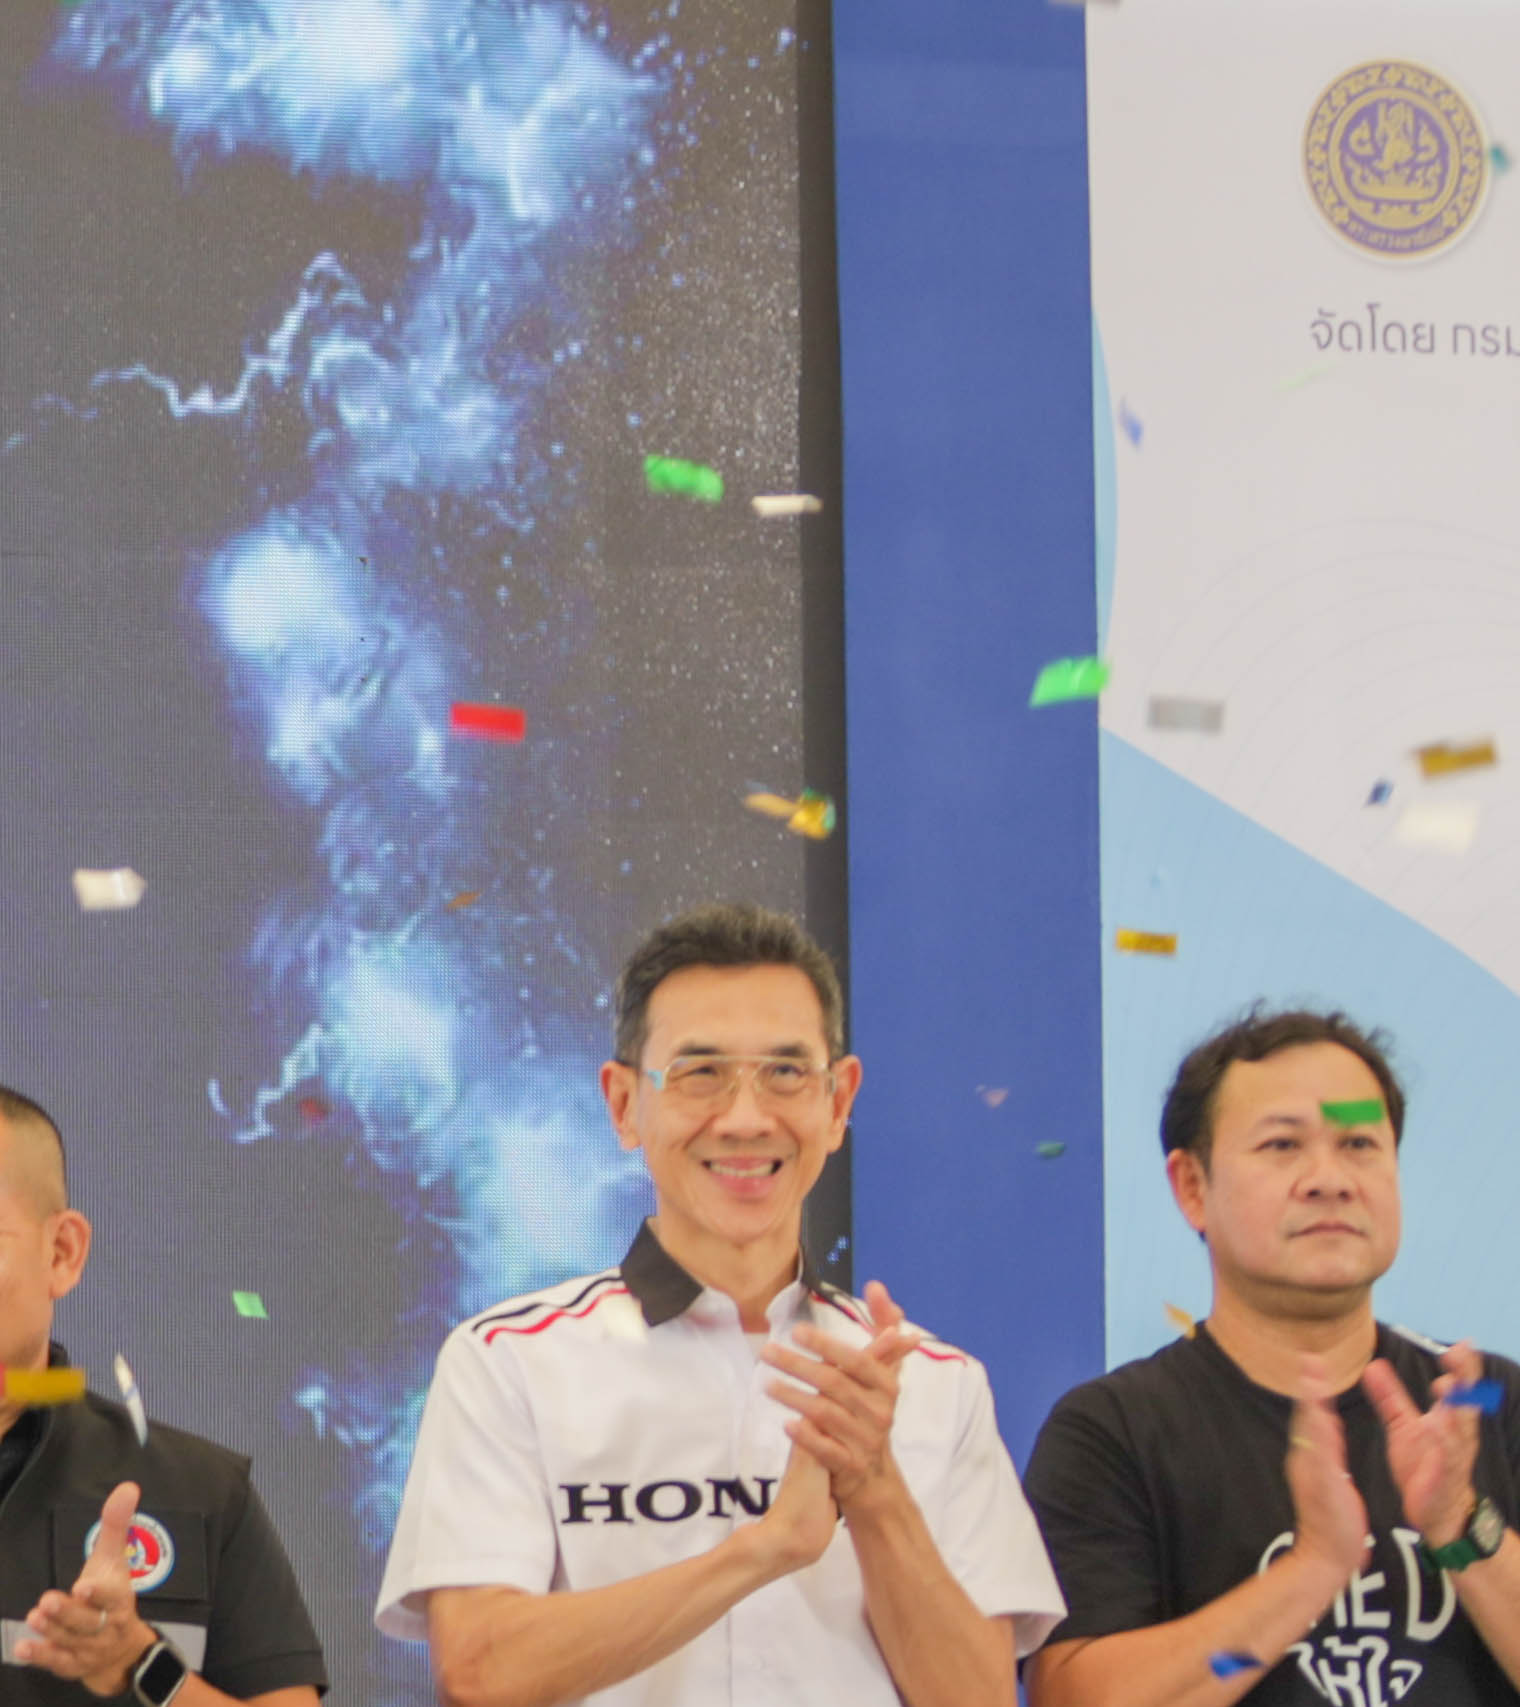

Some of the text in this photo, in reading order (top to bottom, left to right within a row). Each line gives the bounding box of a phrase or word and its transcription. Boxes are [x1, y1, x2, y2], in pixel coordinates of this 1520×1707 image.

[1309, 302, 1436, 353] จัดโดย
[558, 1475, 849, 1527] HON
